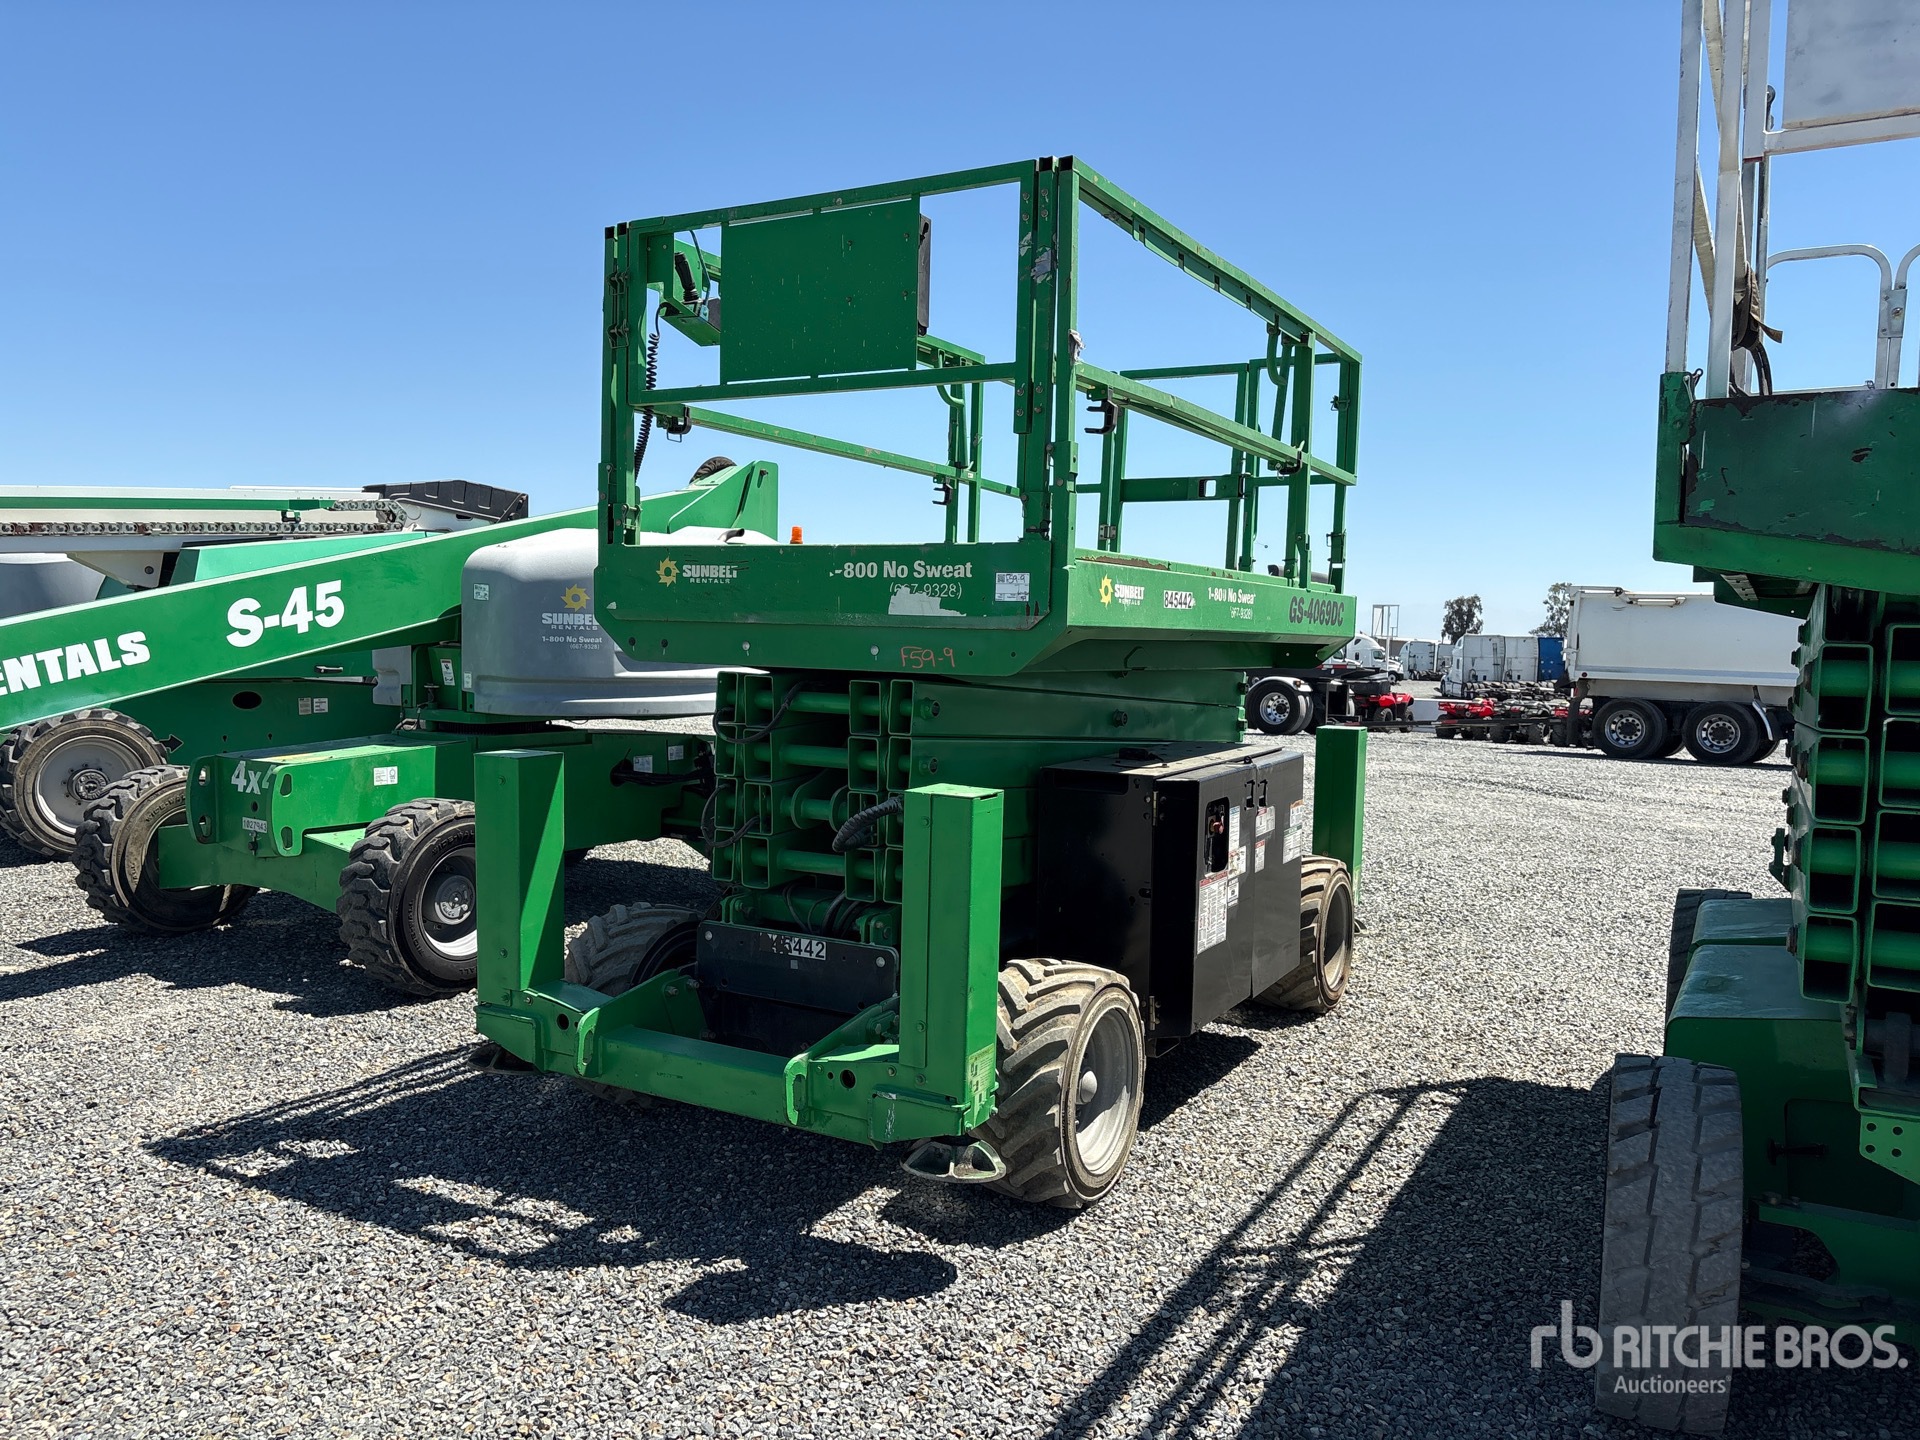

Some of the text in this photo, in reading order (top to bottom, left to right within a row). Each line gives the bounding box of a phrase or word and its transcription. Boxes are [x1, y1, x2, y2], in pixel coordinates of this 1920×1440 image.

[682, 564, 738, 578] SUNBELT
[829, 560, 973, 578] -800 No Sweat
[1114, 584, 1145, 600] SUNBELT
[1164, 591, 1192, 609] 845442
[1207, 586, 1226, 602] 1-800
[1227, 587, 1237, 603] No
[226, 580, 345, 648] S-45
[1289, 595, 1344, 627] GS-4069DC
[899, 646, 956, 669] F59-9
